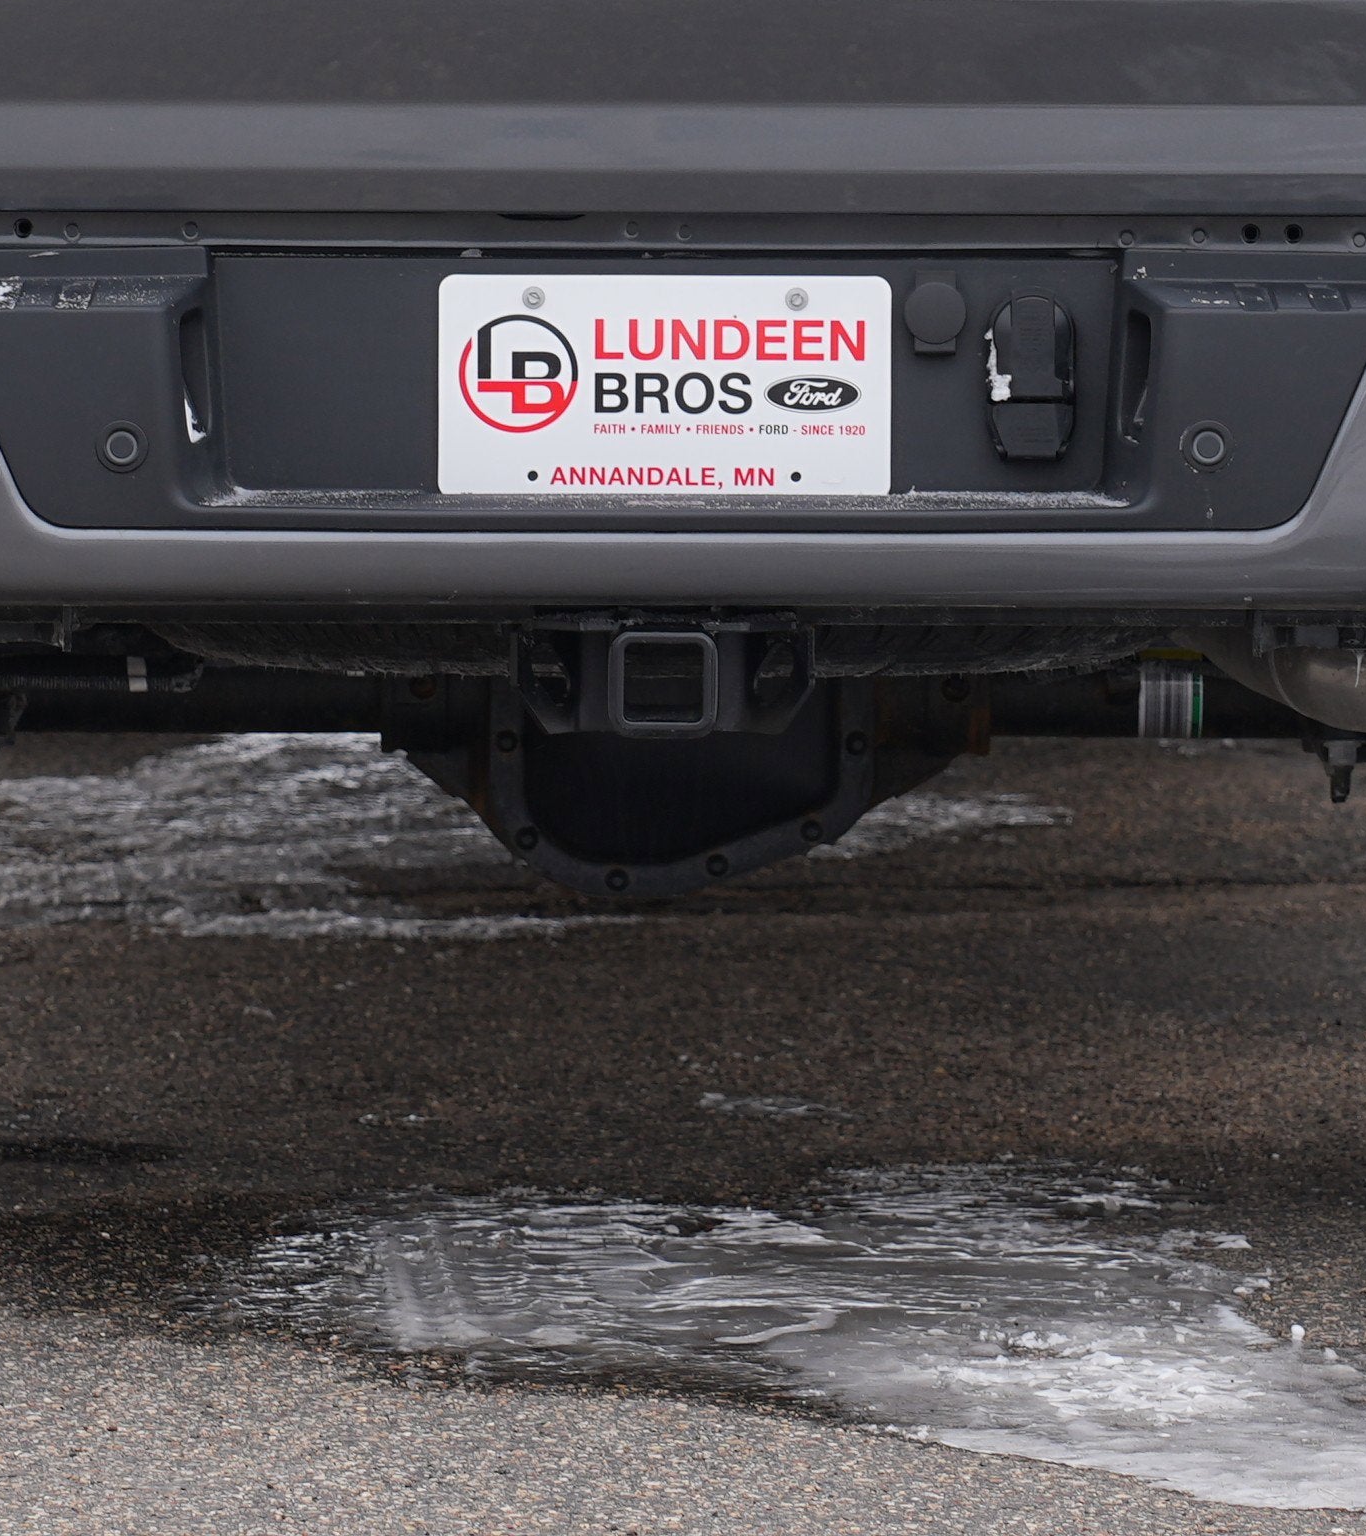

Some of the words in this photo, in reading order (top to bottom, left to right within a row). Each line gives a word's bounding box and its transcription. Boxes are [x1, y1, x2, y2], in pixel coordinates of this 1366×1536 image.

[594, 318, 866, 361] LUNDEEN
[594, 372, 753, 414] BROS
[784, 380, 842, 408] Ford
[593, 424, 626, 435] FAITH
[641, 424, 681, 435] FAMILY
[696, 424, 744, 435] FRIENDS
[759, 424, 789, 435] FORD
[801, 424, 834, 435] SINCE
[839, 424, 866, 436] 1920
[550, 467, 724, 489] ANNANDALE,
[734, 468, 776, 486] MN
